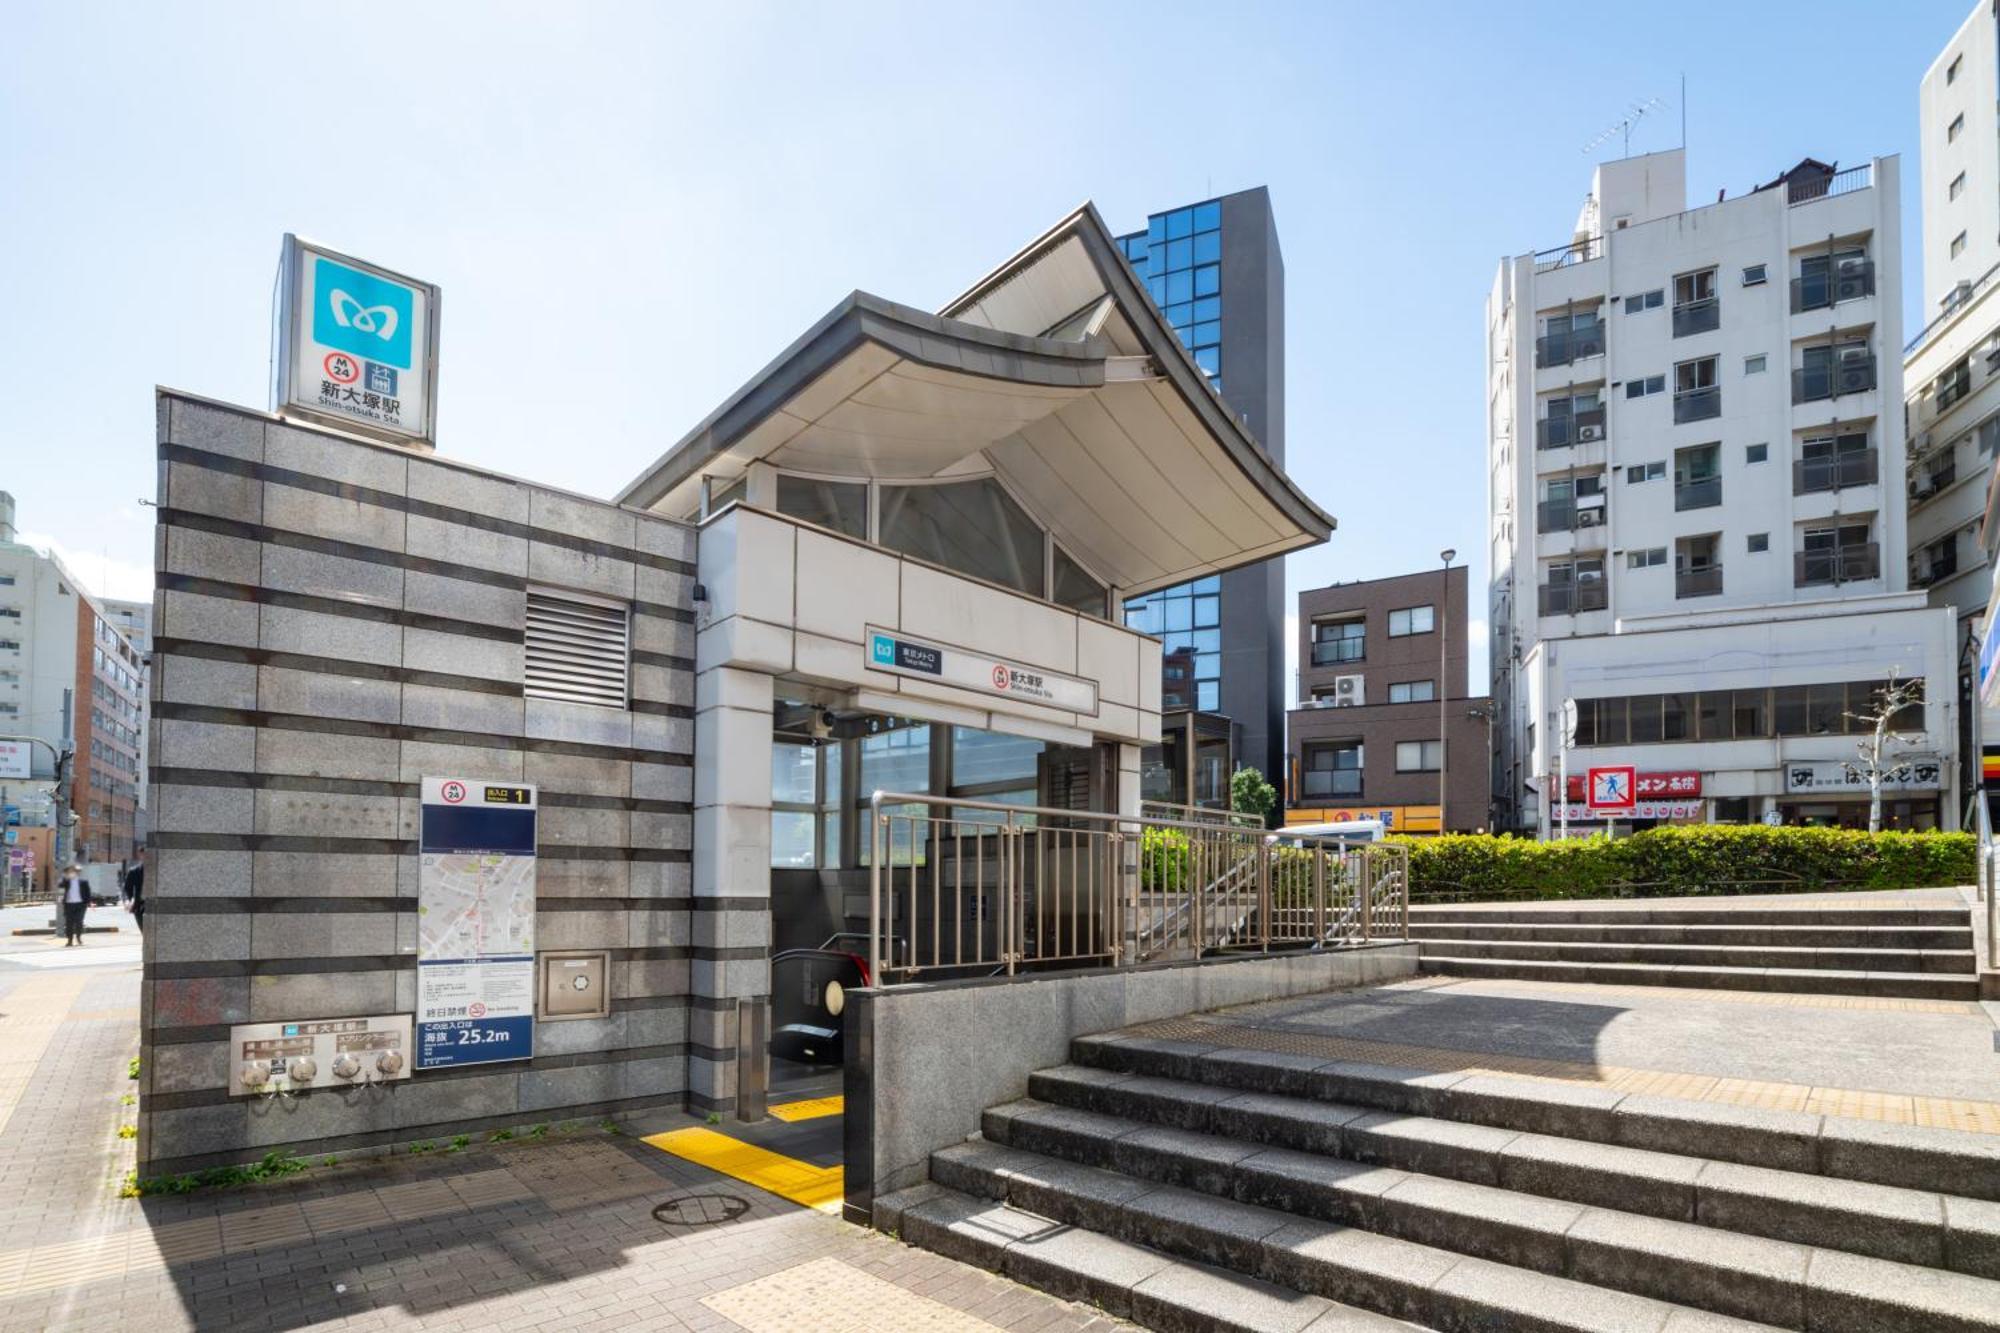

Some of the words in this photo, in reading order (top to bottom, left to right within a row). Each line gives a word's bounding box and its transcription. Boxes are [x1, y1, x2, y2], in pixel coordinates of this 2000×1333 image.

[336, 358, 348, 367] M
[334, 366, 350, 377] 24
[321, 380, 400, 415] 新大塚駅
[318, 396, 380, 419] Shin-otsuka
[1010, 670, 1043, 688] 新大塚駅
[448, 791, 459, 799] 24
[516, 790, 523, 803] 1
[424, 1020, 473, 1031] この出入口は
[458, 1029, 510, 1045] 25.2m
